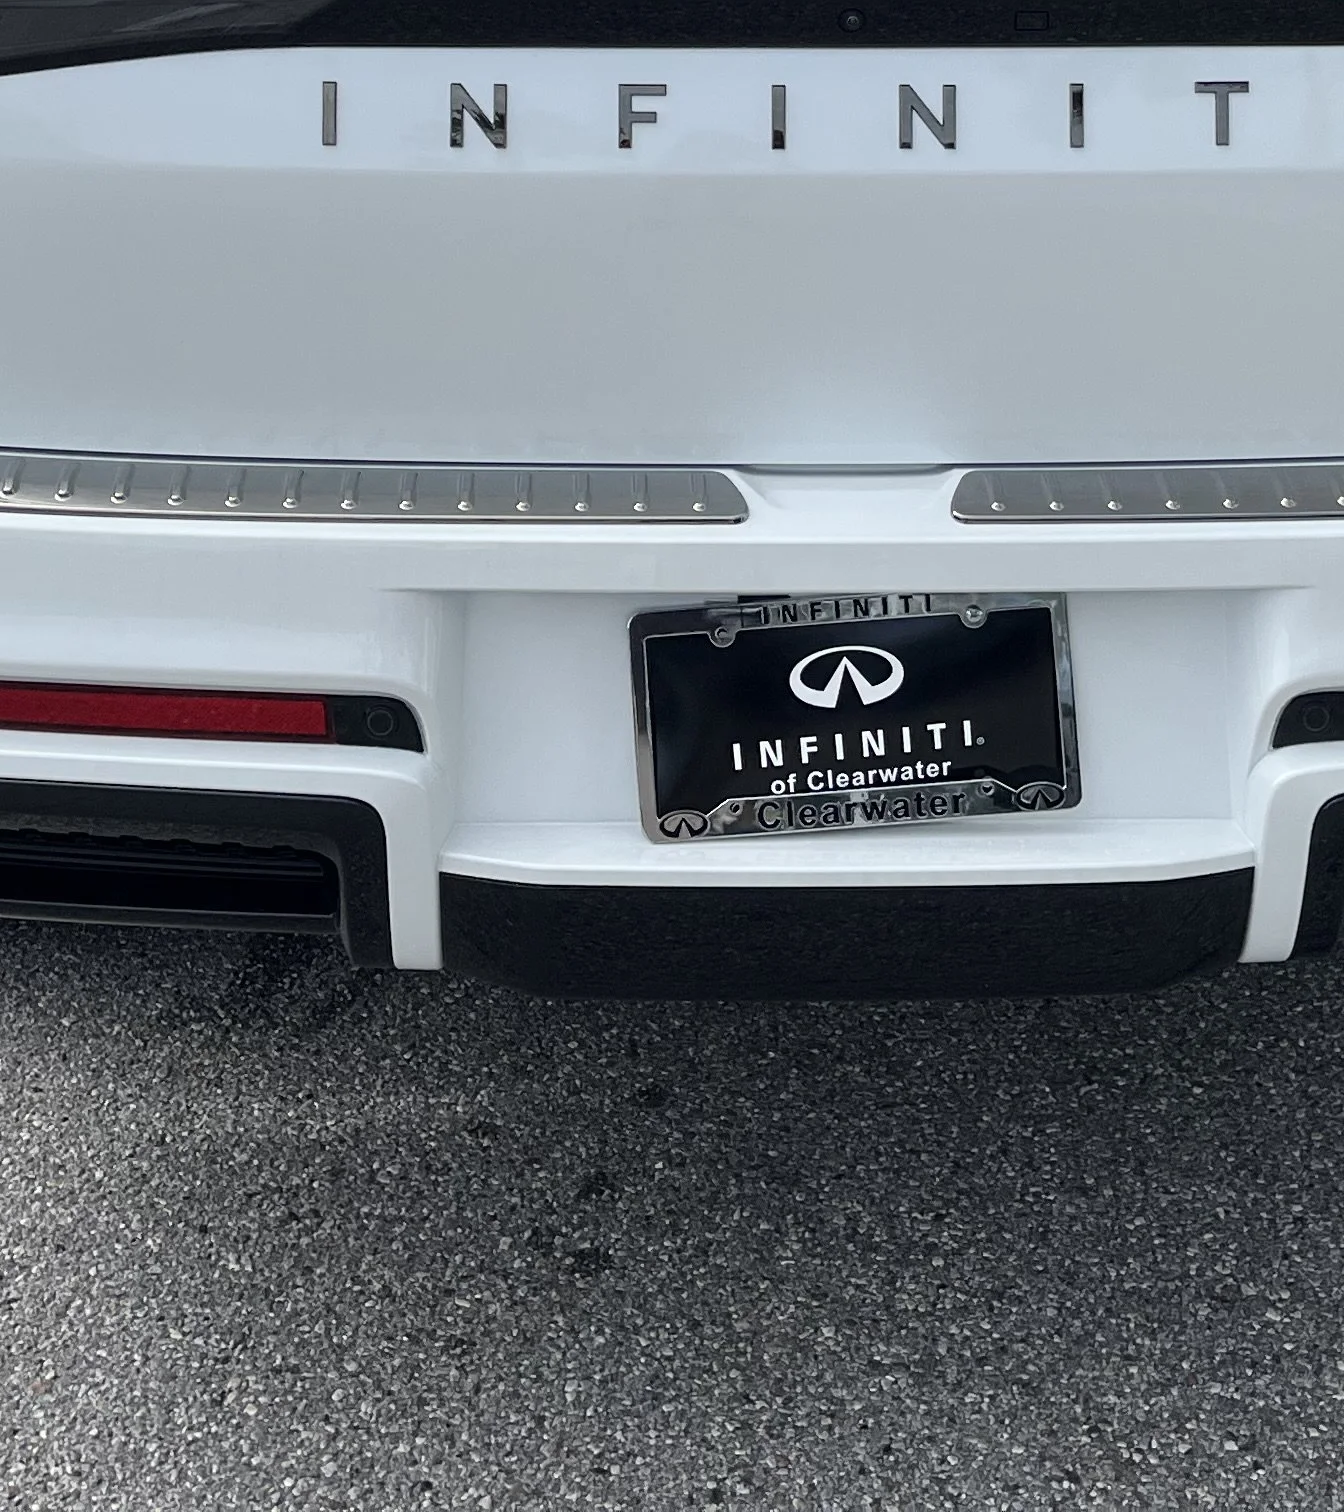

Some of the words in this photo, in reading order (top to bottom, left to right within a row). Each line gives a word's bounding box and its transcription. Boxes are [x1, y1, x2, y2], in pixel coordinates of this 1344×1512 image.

[761, 593, 934, 626] INFINITI
[770, 773, 797, 796] of
[807, 760, 953, 791] Clearwater
[757, 790, 967, 830] Clearwater
